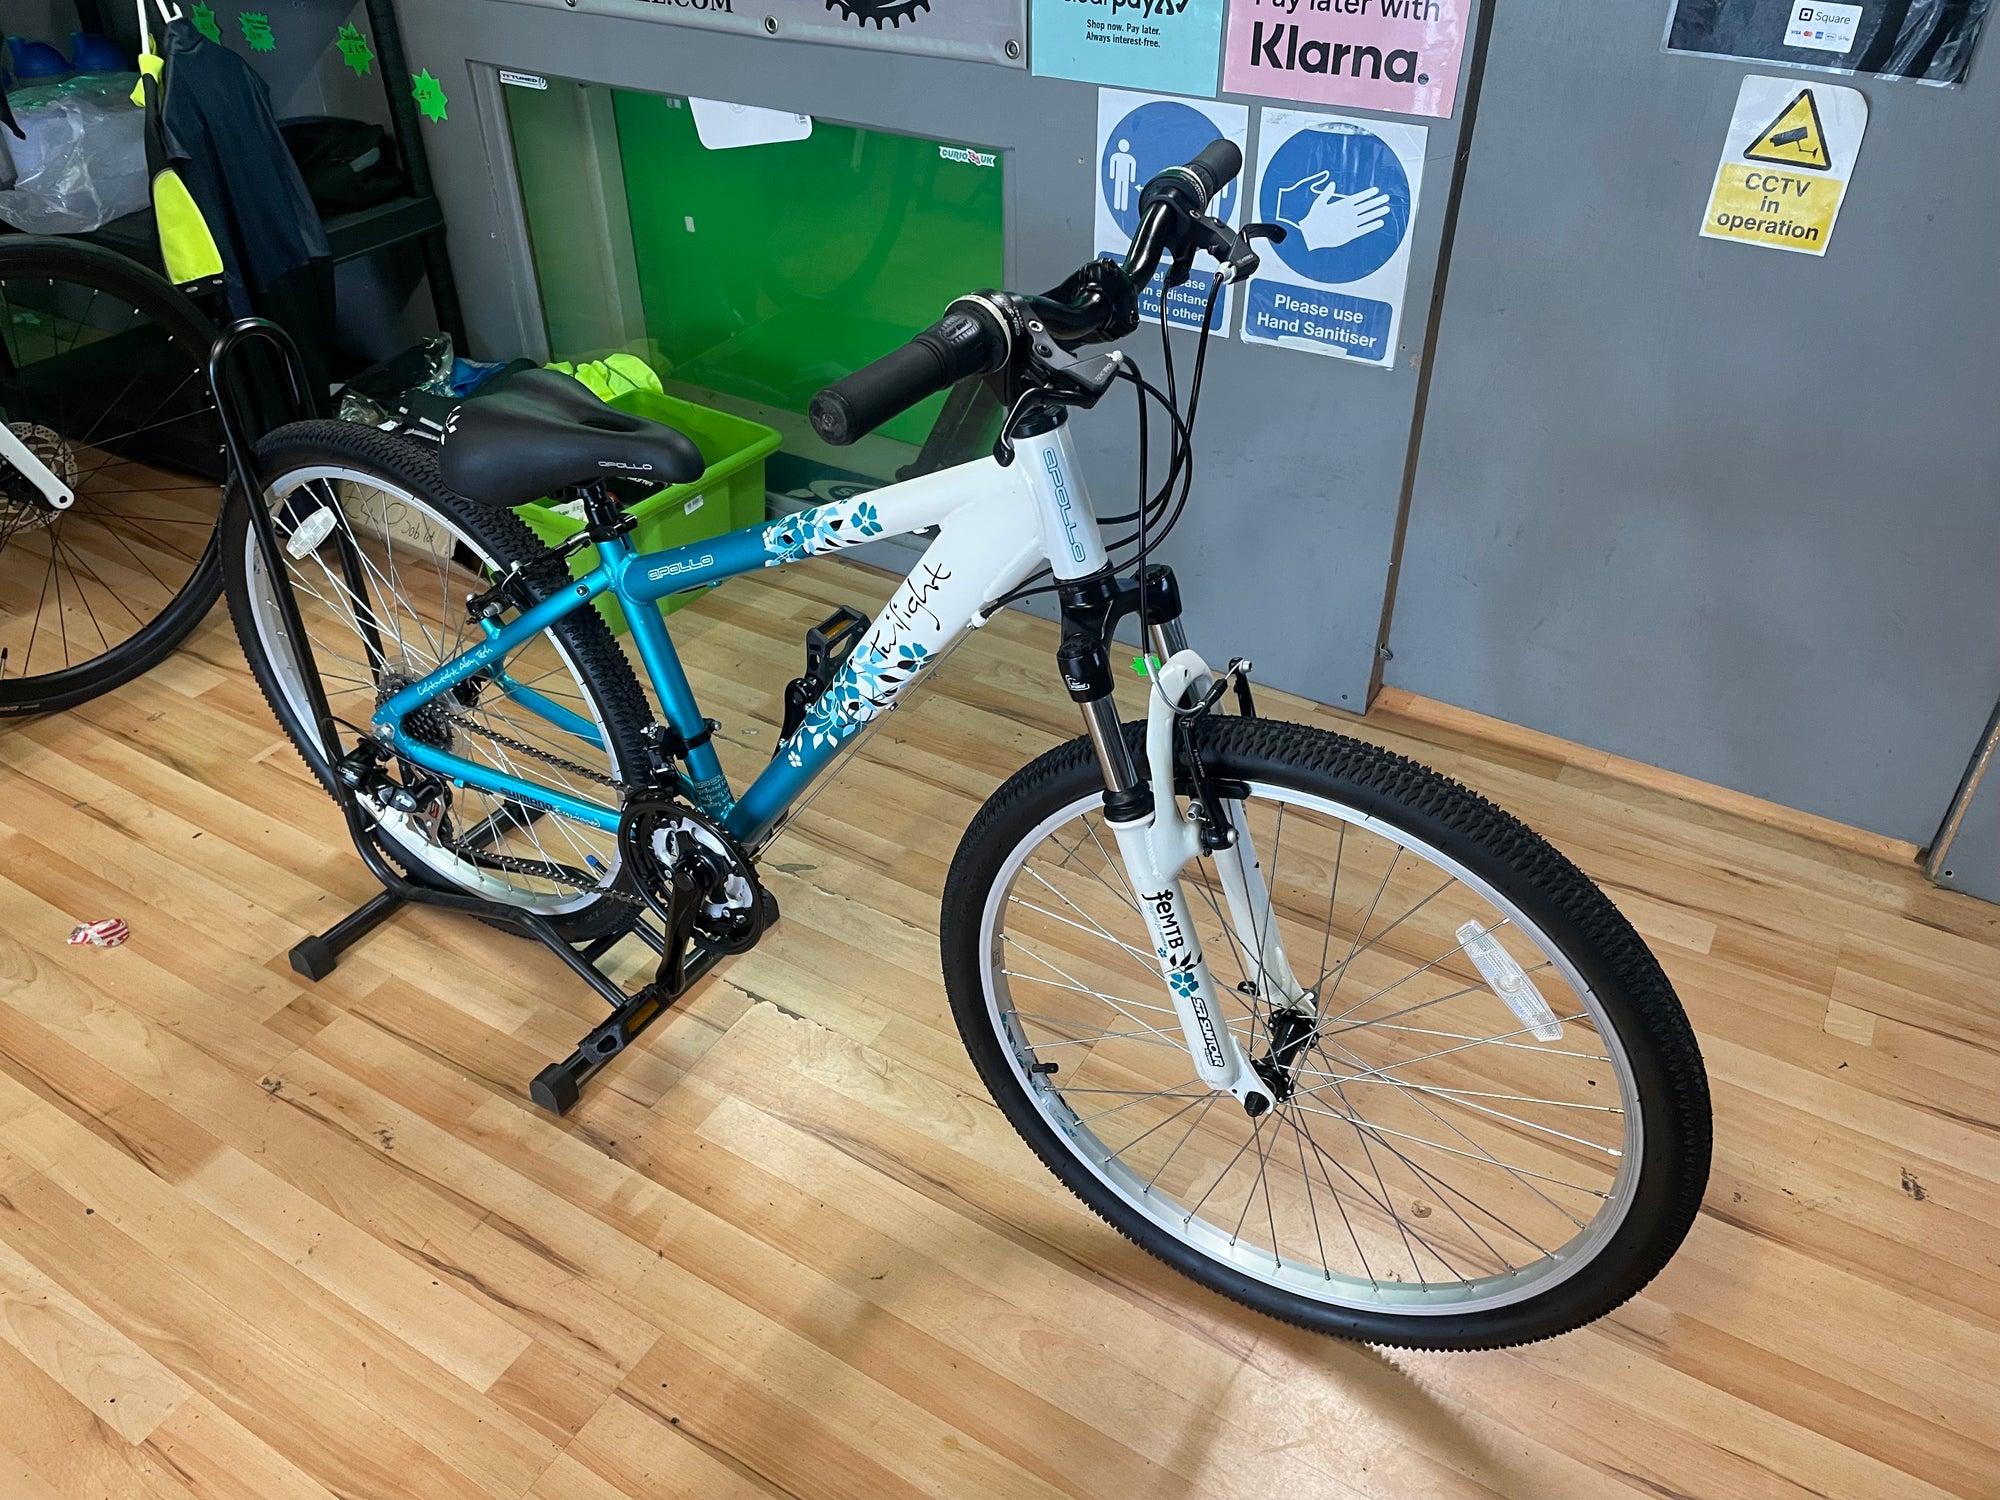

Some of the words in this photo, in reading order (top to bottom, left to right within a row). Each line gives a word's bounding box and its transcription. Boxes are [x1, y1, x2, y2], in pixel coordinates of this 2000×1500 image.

[1380, 0, 1440, 21] with
[1815, 11, 1851, 24] Square
[1087, 19, 1105, 30] Shop
[1107, 23, 1125, 32] now.
[1126, 23, 1140, 34] Pay
[1141, 25, 1161, 35] later.
[1085, 31, 1111, 43] Always
[1112, 35, 1161, 48] interest-free.
[1250, 21, 1429, 85] Klarna.
[980, 155, 993, 164] UK
[1744, 172, 1811, 198] CCTV
[1760, 196, 1780, 214] in
[1716, 211, 1819, 241] operation
[1166, 289, 1208, 307] distanc
[1274, 293, 1329, 317] Please
[1333, 308, 1364, 324] use
[1172, 307, 1205, 323] other
[1256, 311, 1300, 333] Hand
[1303, 321, 1377, 348] Sanitiser
[1043, 447, 1086, 562] APOLLO
[647, 554, 714, 581] APOLLO
[500, 787, 553, 811] SHIMANO
